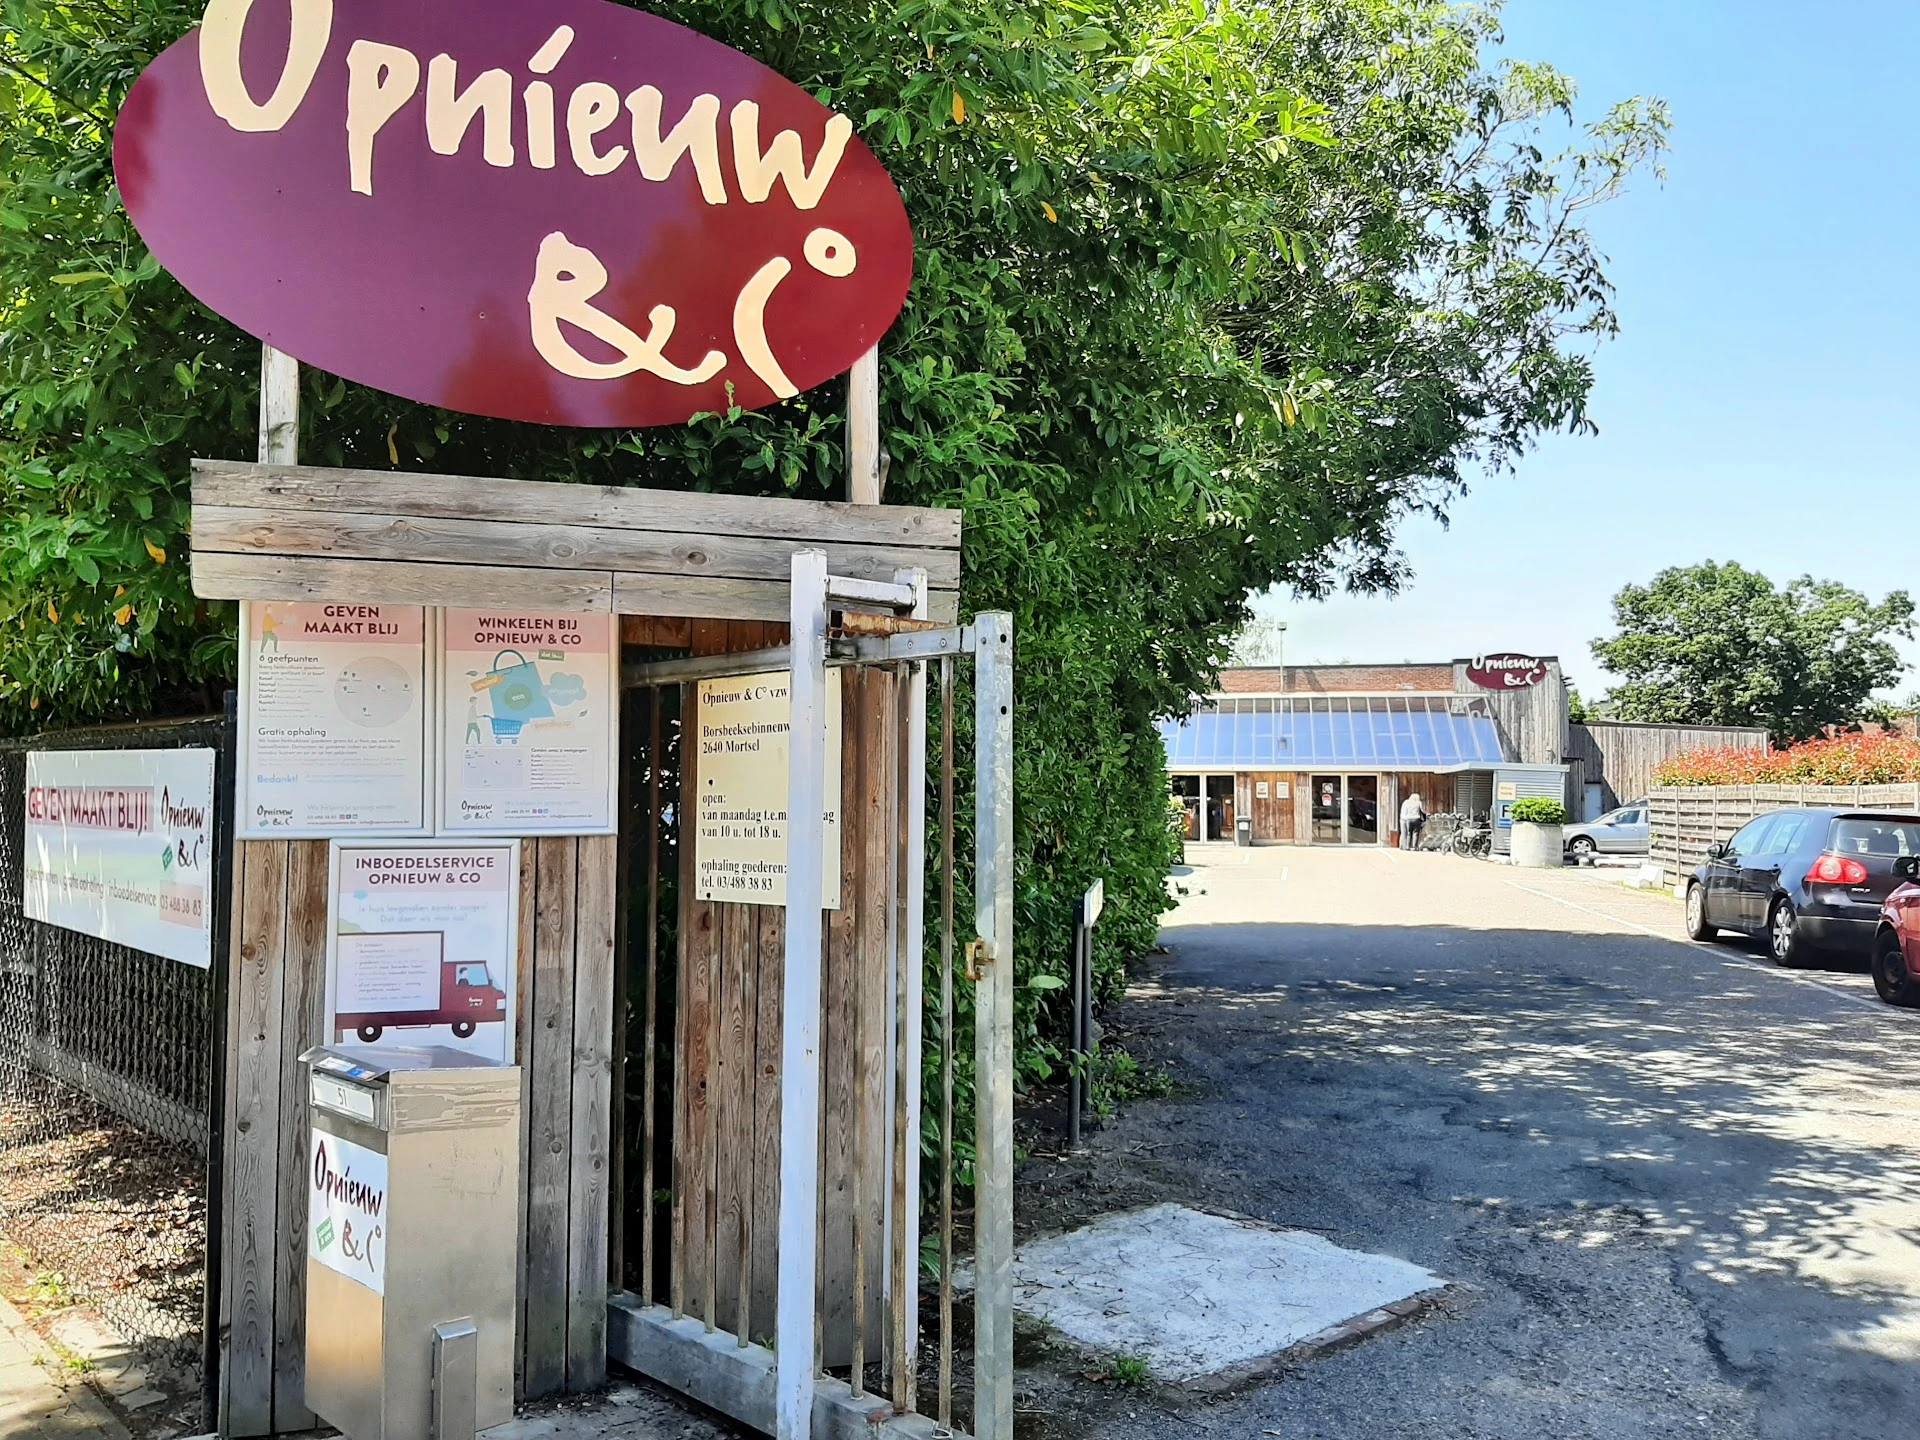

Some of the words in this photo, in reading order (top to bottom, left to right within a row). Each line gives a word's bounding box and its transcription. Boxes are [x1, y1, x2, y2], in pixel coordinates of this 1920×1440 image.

[528, 230, 728, 385] &
[324, 605, 380, 618] GEVEN
[304, 621, 364, 634] MAAKT
[368, 623, 399, 635] BLIJ
[478, 617, 555, 630] WINKELEN
[558, 619, 578, 631] BIJ
[474, 633, 546, 645] OPNIEUW
[548, 634, 557, 645] &
[561, 634, 582, 645] CO
[259, 655, 265, 663] 6
[268, 653, 319, 664] geefpunten
[703, 691, 741, 708] Opnieuw
[744, 688, 753, 701] &
[769, 687, 789, 698] vzw
[258, 727, 285, 736] Gratis
[287, 727, 327, 738] ophaling
[703, 722, 790, 738] Borsbeeksebinnenw
[703, 741, 723, 754] 2640
[725, 739, 760, 753] Mortsel
[257, 775, 299, 784] Bedankt!
[702, 793, 727, 807] open:
[28, 788, 67, 821] GEVEN
[71, 789, 115, 827] MAAKT
[118, 792, 148, 837] BLIJ!
[702, 811, 719, 821] van
[720, 810, 762, 824] maandag
[702, 828, 718, 838] van
[720, 826, 731, 838] 10
[733, 829, 742, 838] u.
[744, 827, 757, 838] tot
[759, 825, 770, 838] 18
[772, 829, 781, 839] u.
[178, 839, 193, 868] &
[356, 857, 495, 869] INBOEDELSERVICE
[701, 860, 740, 875] ophaling
[742, 861, 788, 876] goederen:
[368, 873, 441, 885] OPNIEUW
[446, 872, 456, 883] &
[460, 872, 481, 883] CO
[701, 876, 715, 889] tel.
[717, 876, 746, 890] 03/488
[748, 877, 760, 890] 38
[761, 878, 773, 891] 83
[108, 878, 157, 907] inboedelservice
[338, 1087, 348, 1108] 51
[342, 1218, 364, 1261] &
